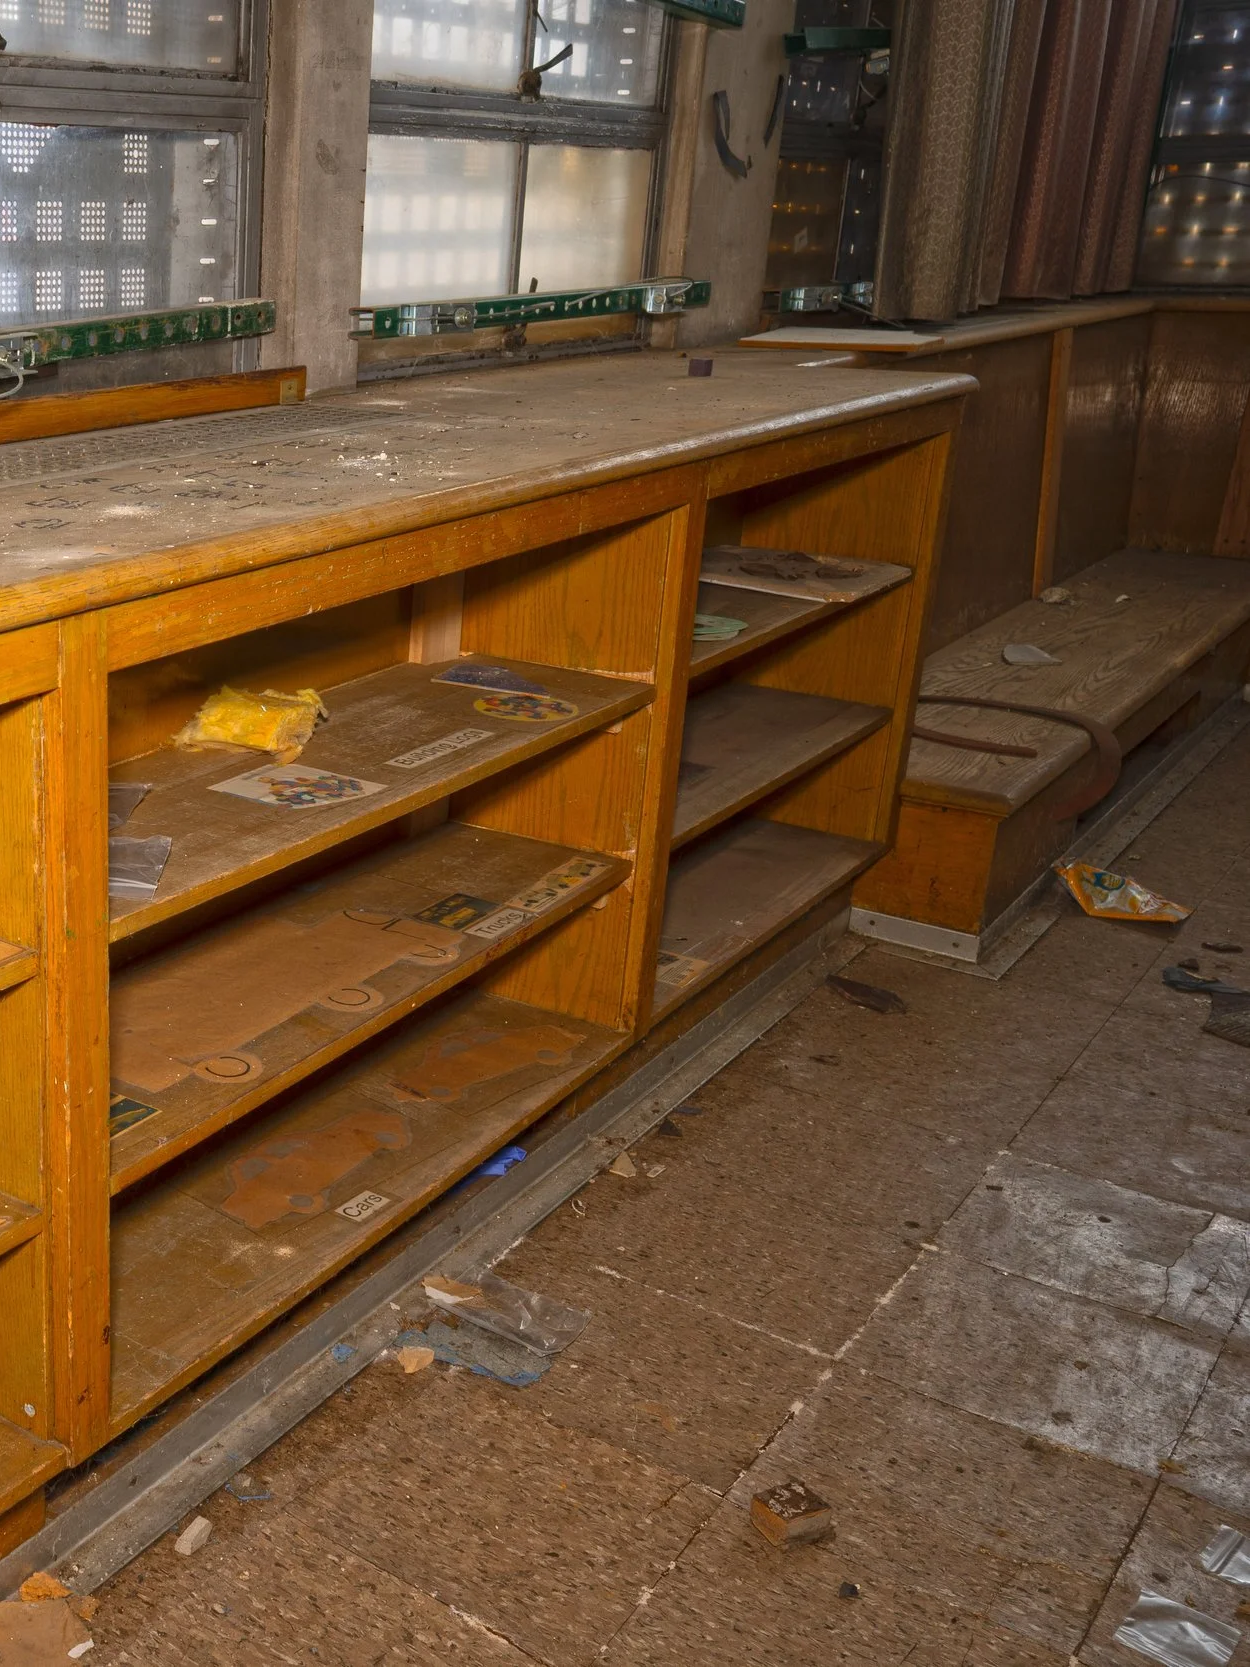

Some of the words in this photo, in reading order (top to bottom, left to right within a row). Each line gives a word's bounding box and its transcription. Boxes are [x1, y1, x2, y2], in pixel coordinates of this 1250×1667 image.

[394, 743, 457, 765] Building
[475, 912, 522, 934] Trucks
[342, 1194, 382, 1217] Cars
